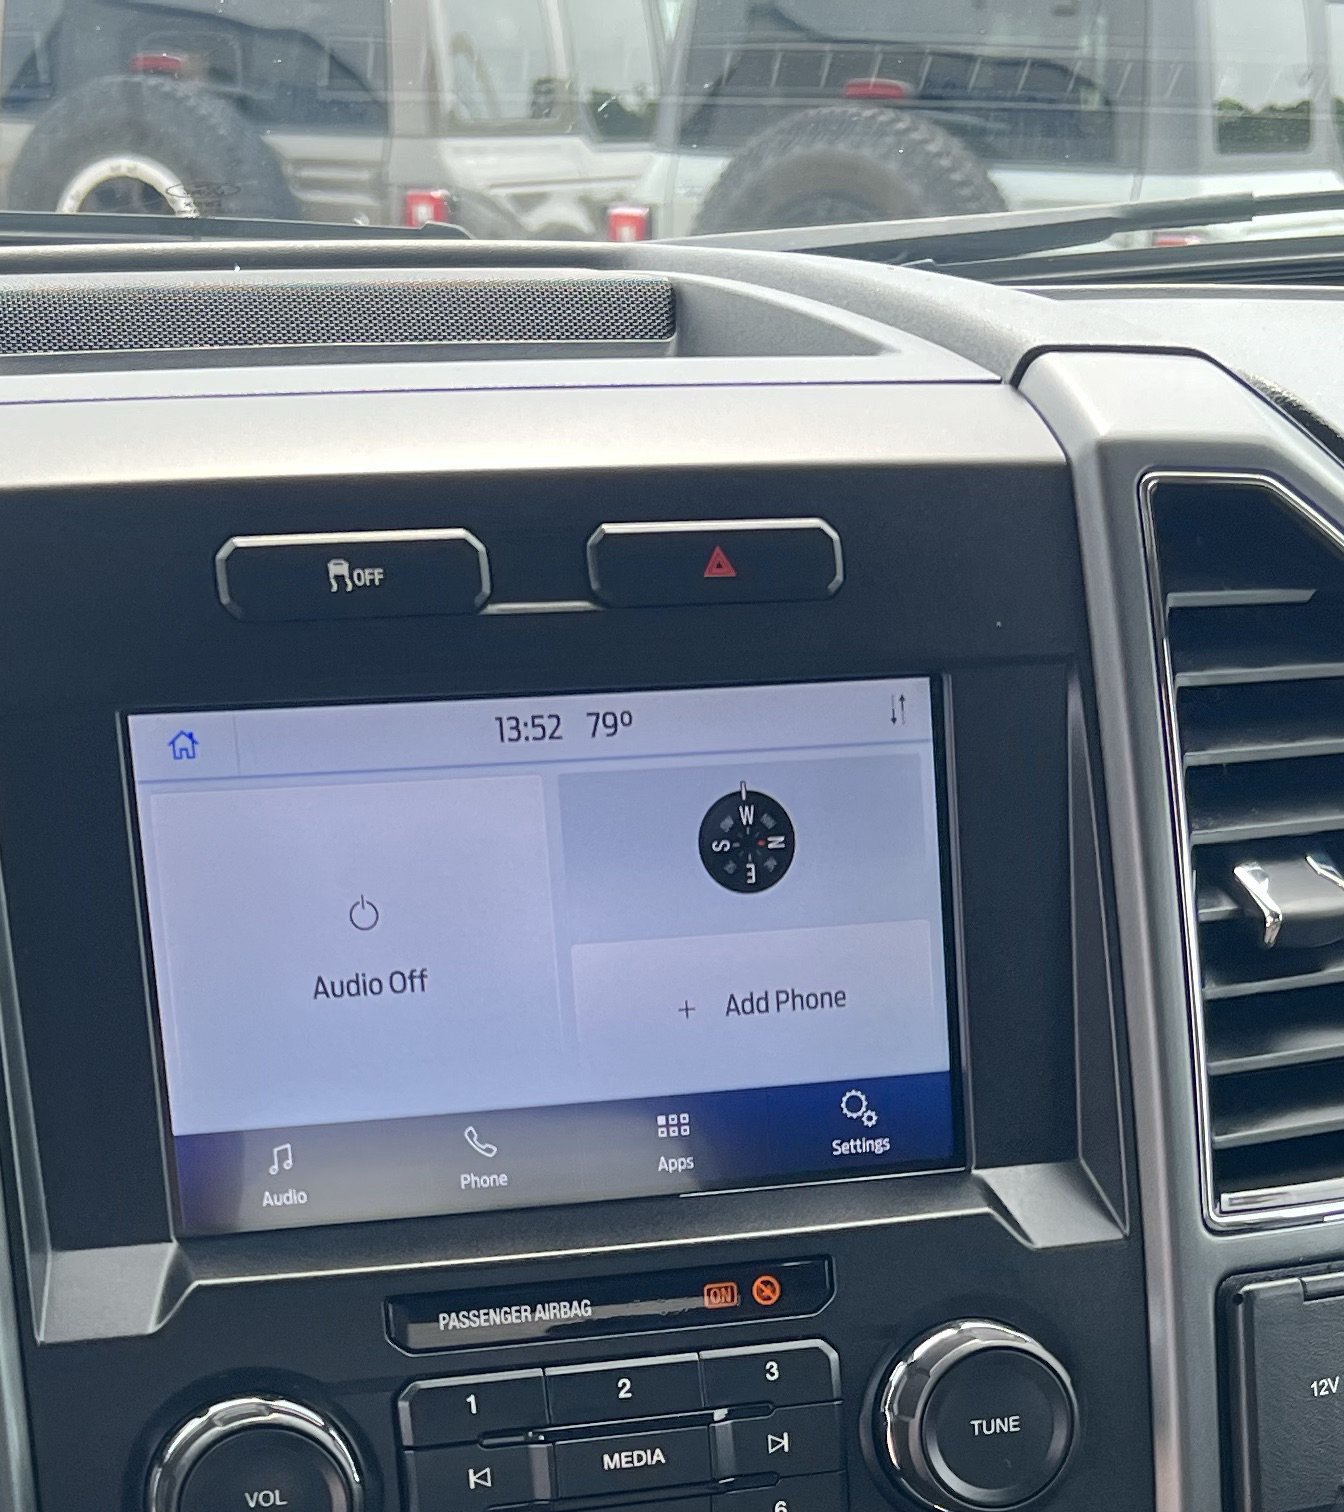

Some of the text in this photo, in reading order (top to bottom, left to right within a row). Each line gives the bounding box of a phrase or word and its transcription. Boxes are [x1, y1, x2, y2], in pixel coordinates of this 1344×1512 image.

[352, 567, 385, 587] OFF
[494, 713, 563, 743] 13:52
[738, 803, 755, 826] W
[711, 839, 731, 853] S
[766, 835, 786, 850] N
[745, 862, 756, 884] E
[313, 967, 429, 1000] Audio Off
[725, 987, 847, 1017] Add Phone
[831, 1136, 891, 1157] Settings
[657, 1155, 695, 1174] Apps
[460, 1172, 508, 1190] Phone
[262, 1187, 308, 1208] Audio
[709, 1286, 734, 1306] ON
[437, 1299, 593, 1332] PASSENGER AIRBAG
[764, 1360, 780, 1382] 3
[616, 1377, 633, 1400] 2
[1309, 1375, 1340, 1398] 12V
[465, 1393, 479, 1415] 1
[969, 1415, 1021, 1436] TUNE
[602, 1446, 666, 1471] MEDIA
[244, 1489, 289, 1508] VOL
